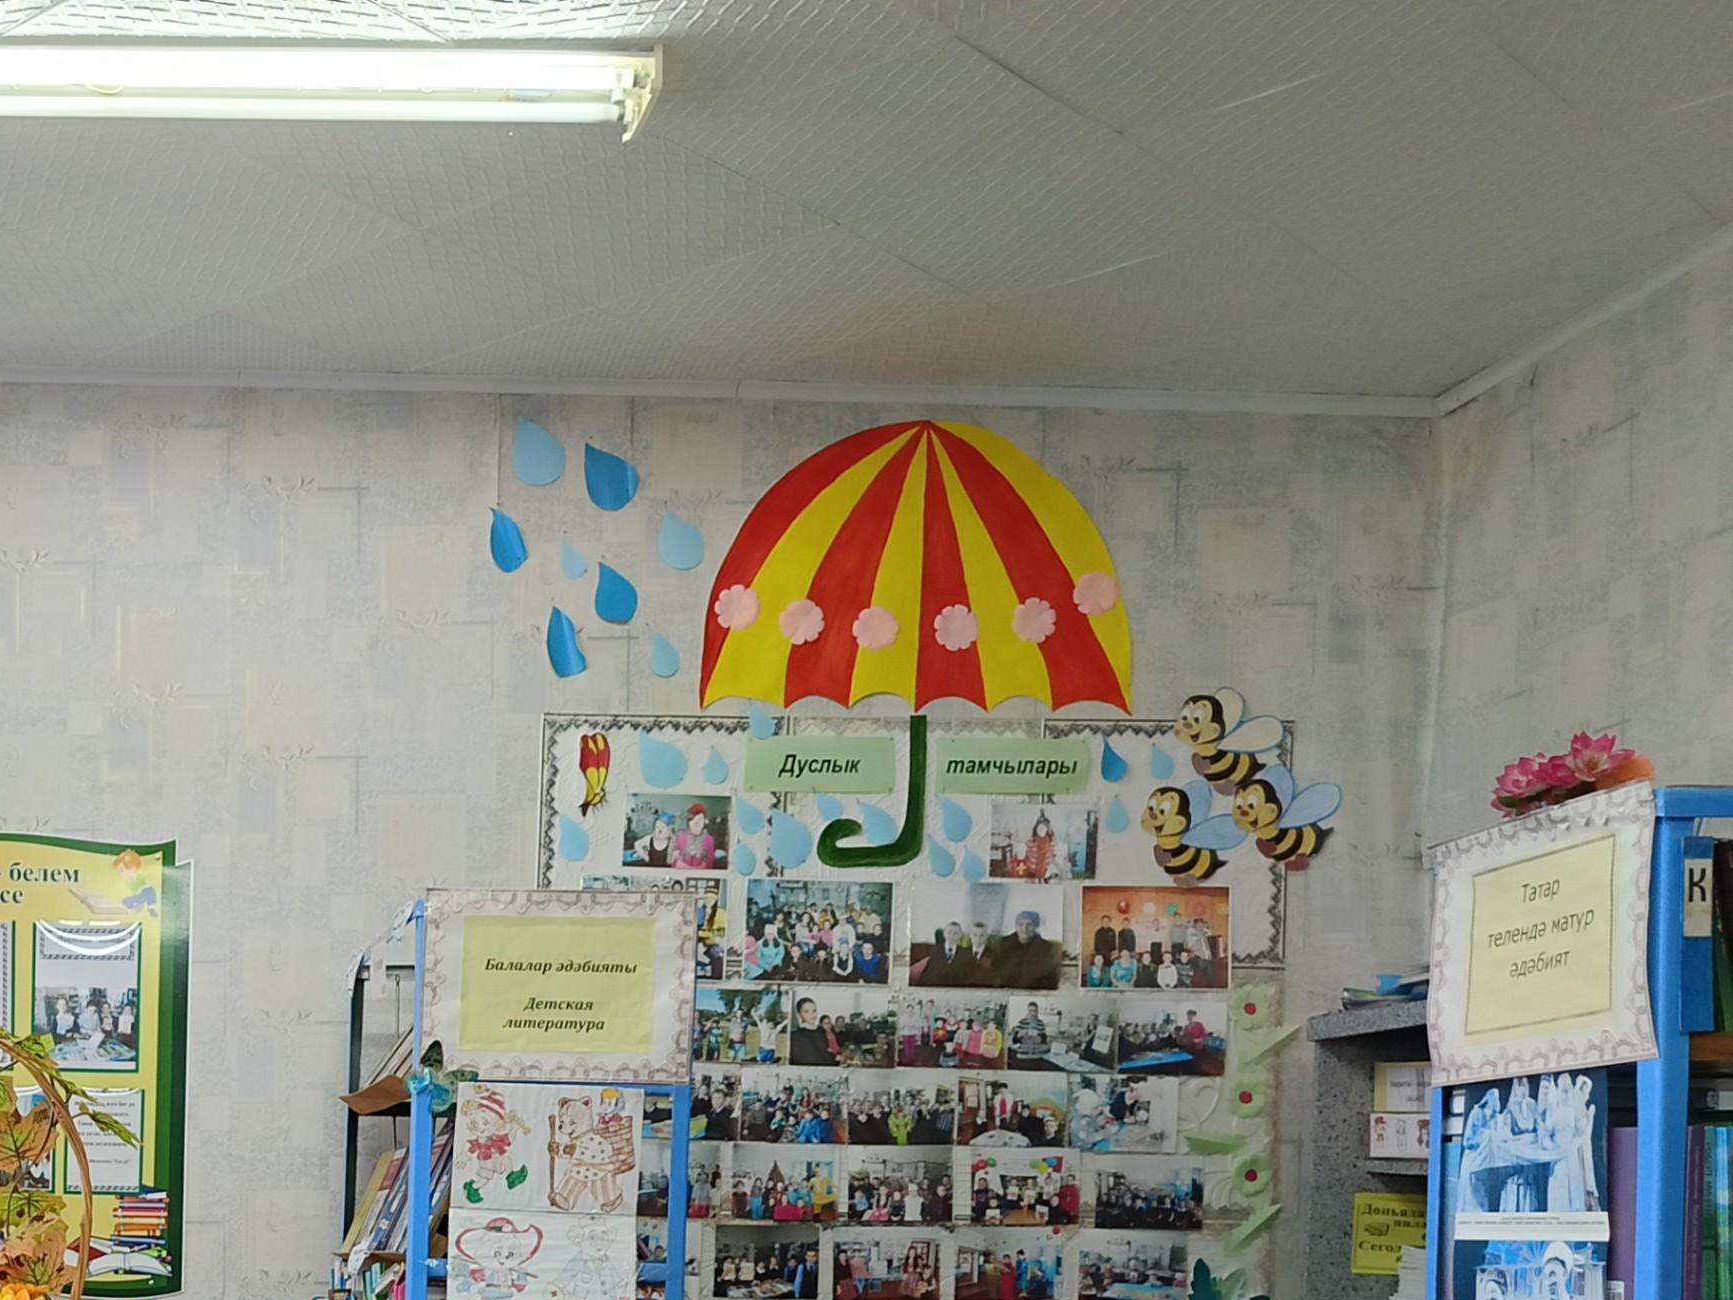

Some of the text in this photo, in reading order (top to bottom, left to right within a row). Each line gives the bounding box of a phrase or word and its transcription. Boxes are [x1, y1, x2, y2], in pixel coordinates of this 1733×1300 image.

[778, 751, 1077, 778] Дуслык тамчылары
[9, 862, 80, 884] белем
[1521, 878, 1561, 907] Татар
[1488, 907, 1596, 951] телендә матур
[484, 957, 637, 977] Балалар әдәбияты
[1509, 948, 1570, 980] әдәбият
[523, 995, 594, 1013] Детская
[503, 1015, 605, 1034] литература
